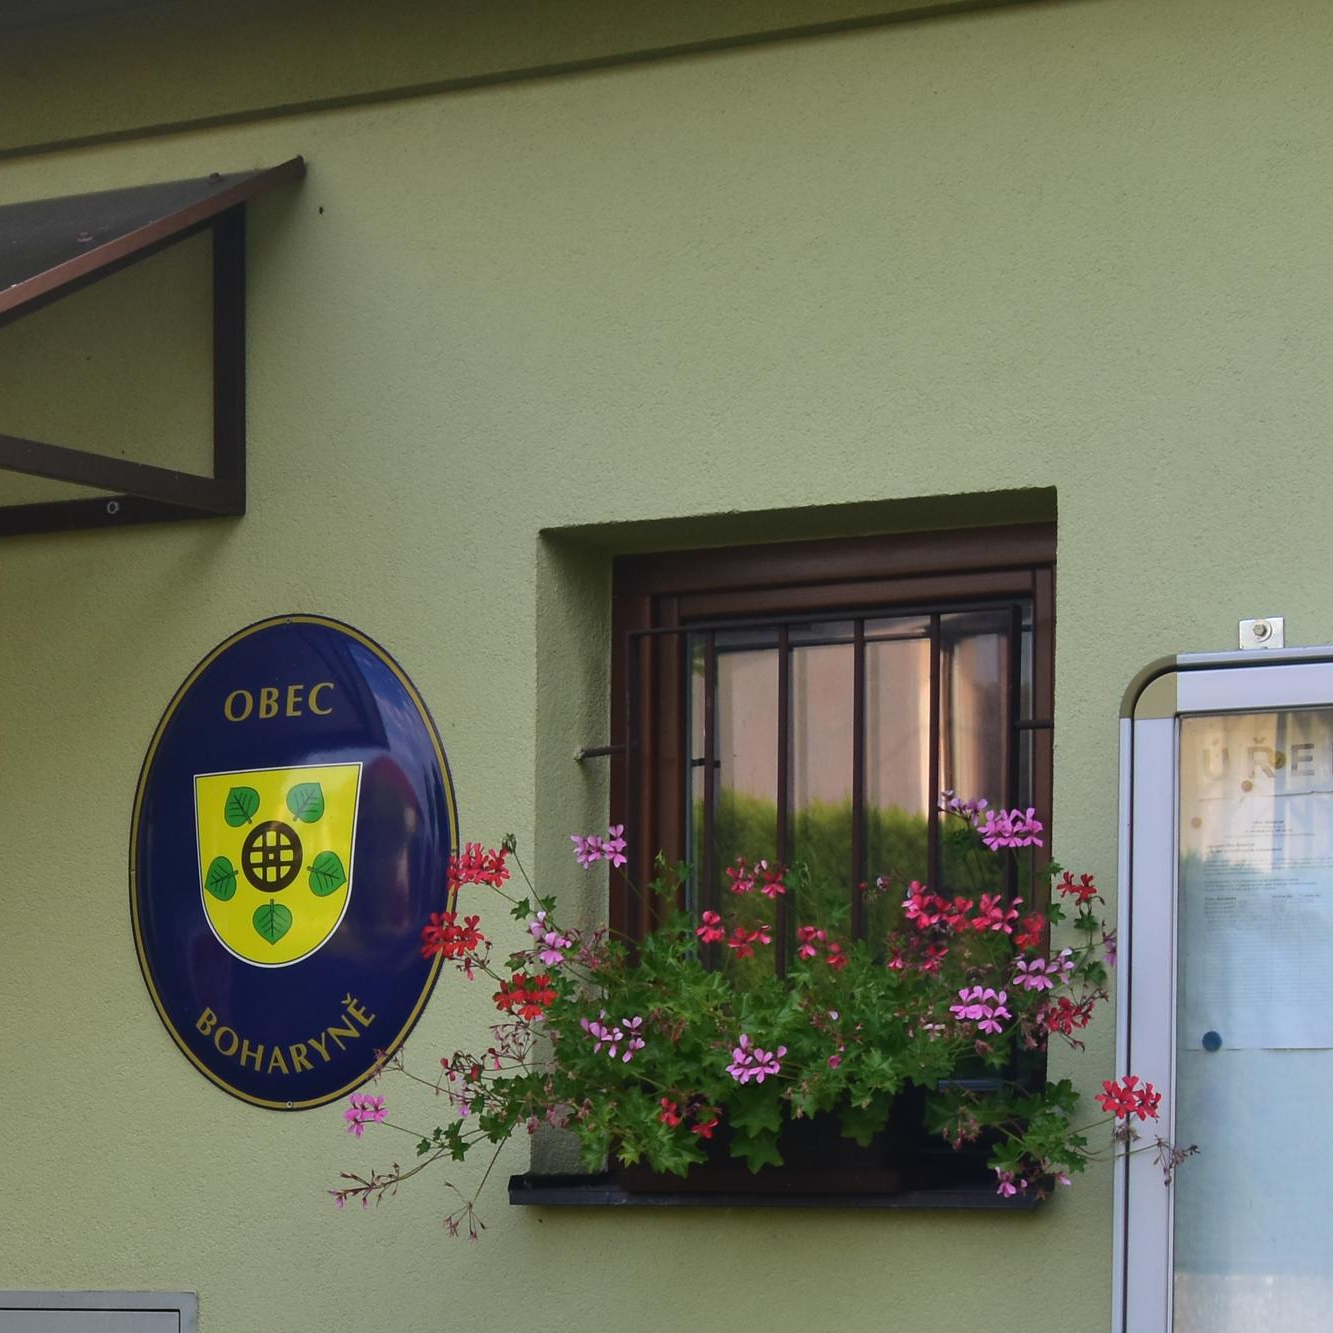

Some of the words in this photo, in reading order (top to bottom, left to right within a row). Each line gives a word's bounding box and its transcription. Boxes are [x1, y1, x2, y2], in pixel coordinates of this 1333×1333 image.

[223, 682, 336, 722] OBEC
[1203, 737, 1333, 781] ÚŘE
[194, 992, 376, 1075] BOHARYNĚ
